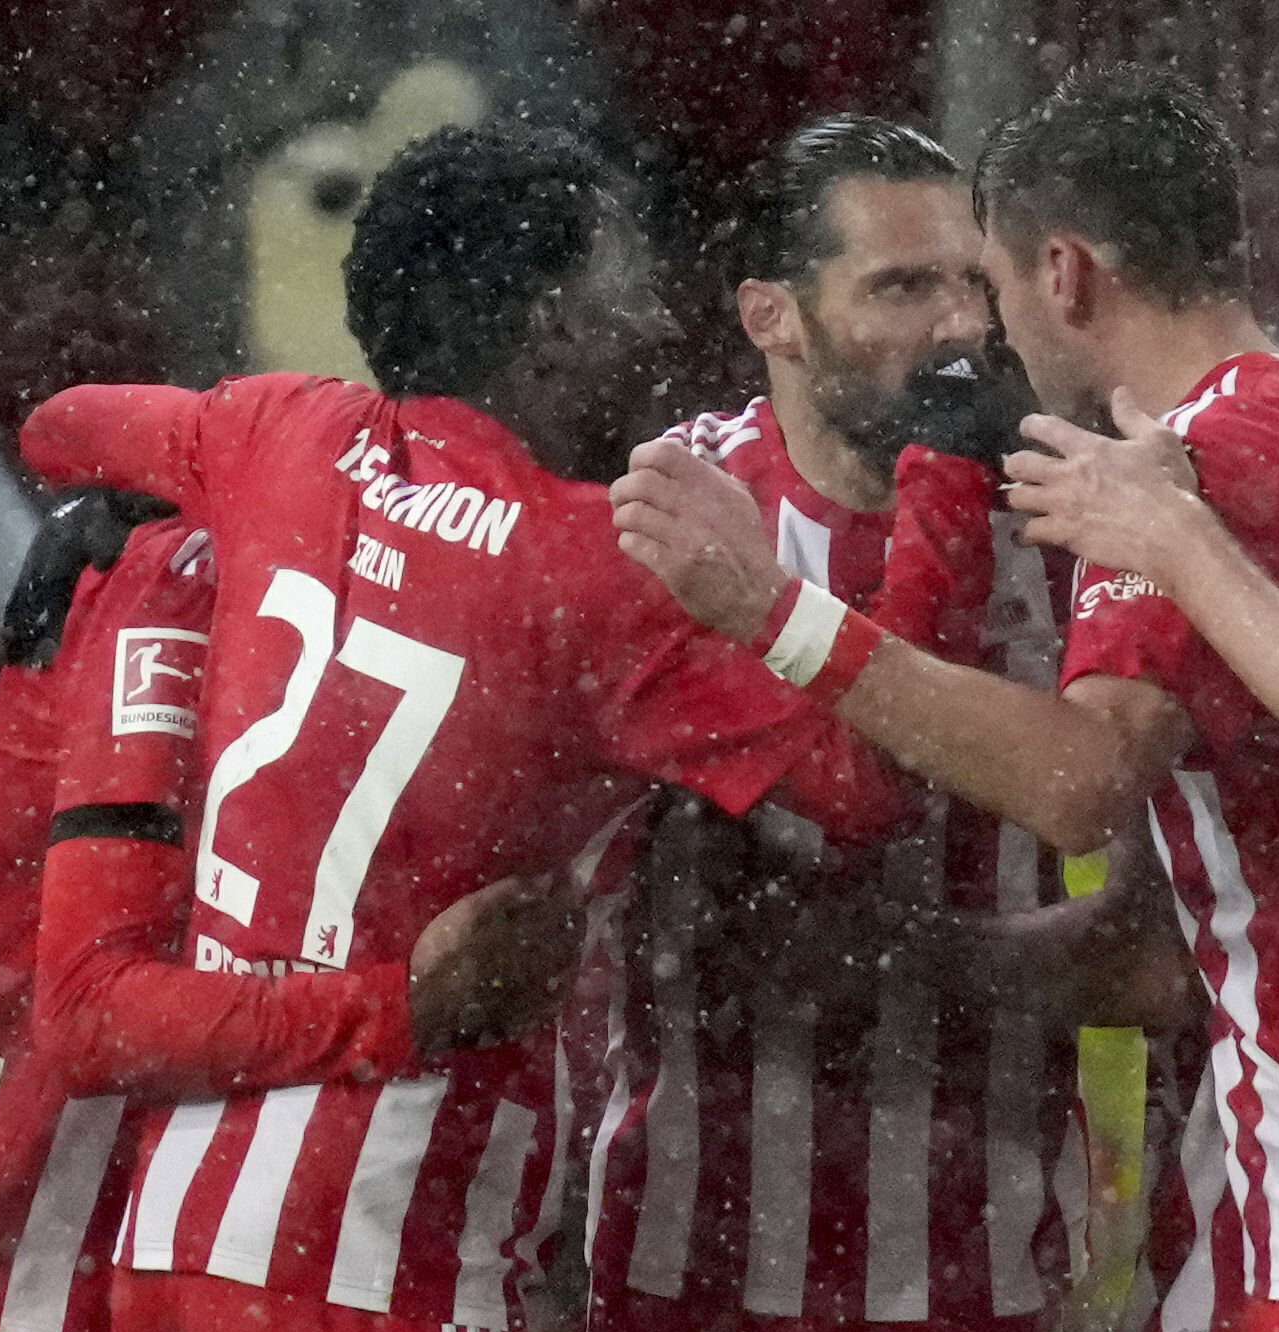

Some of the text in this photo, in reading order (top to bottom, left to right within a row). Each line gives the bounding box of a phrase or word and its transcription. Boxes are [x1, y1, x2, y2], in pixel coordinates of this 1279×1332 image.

[347, 532, 406, 592] ERLIN
[121, 711, 195, 729] BUNDESLIG
[195, 568, 466, 970] 27
